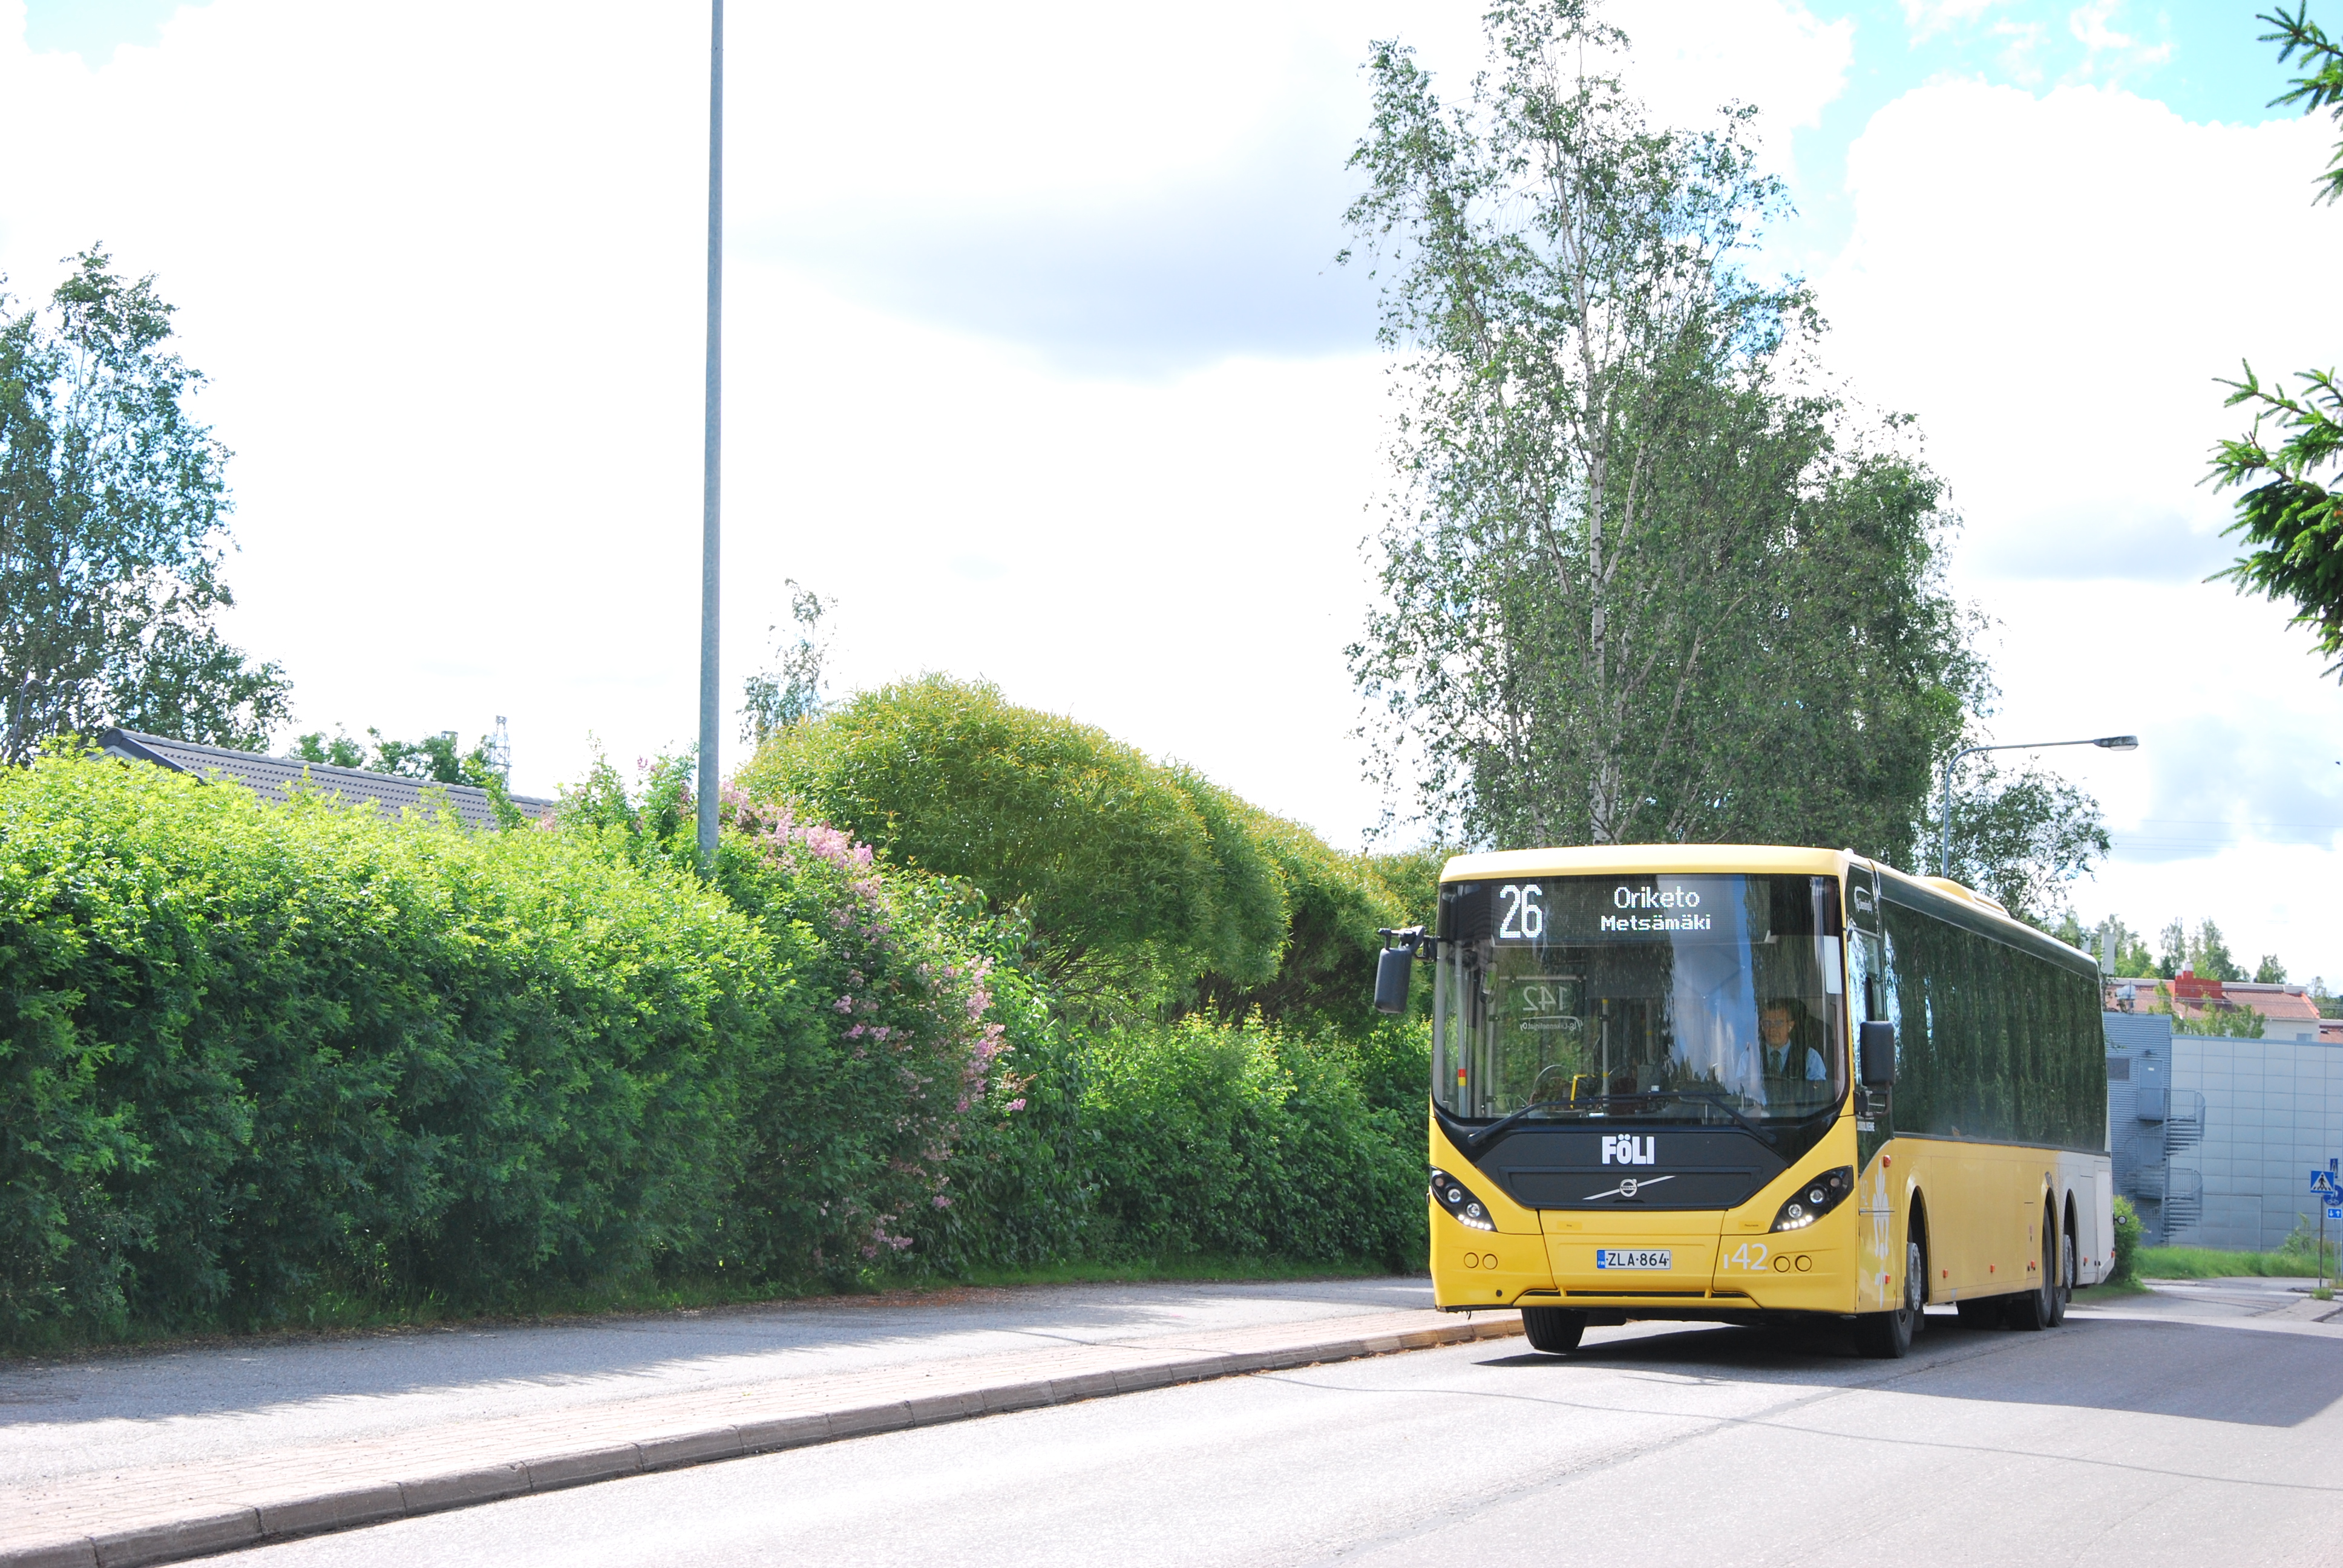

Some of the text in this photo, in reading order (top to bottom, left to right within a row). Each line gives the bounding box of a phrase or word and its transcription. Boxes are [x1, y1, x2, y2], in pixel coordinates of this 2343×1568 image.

[1614, 886, 1700, 908] Oriketo
[1499, 884, 1542, 938] 26
[1601, 914, 1711, 931] Metsämäki
[1602, 1134, 1654, 1165] FÖLI
[1608, 1252, 1668, 1266] ZLA-864
